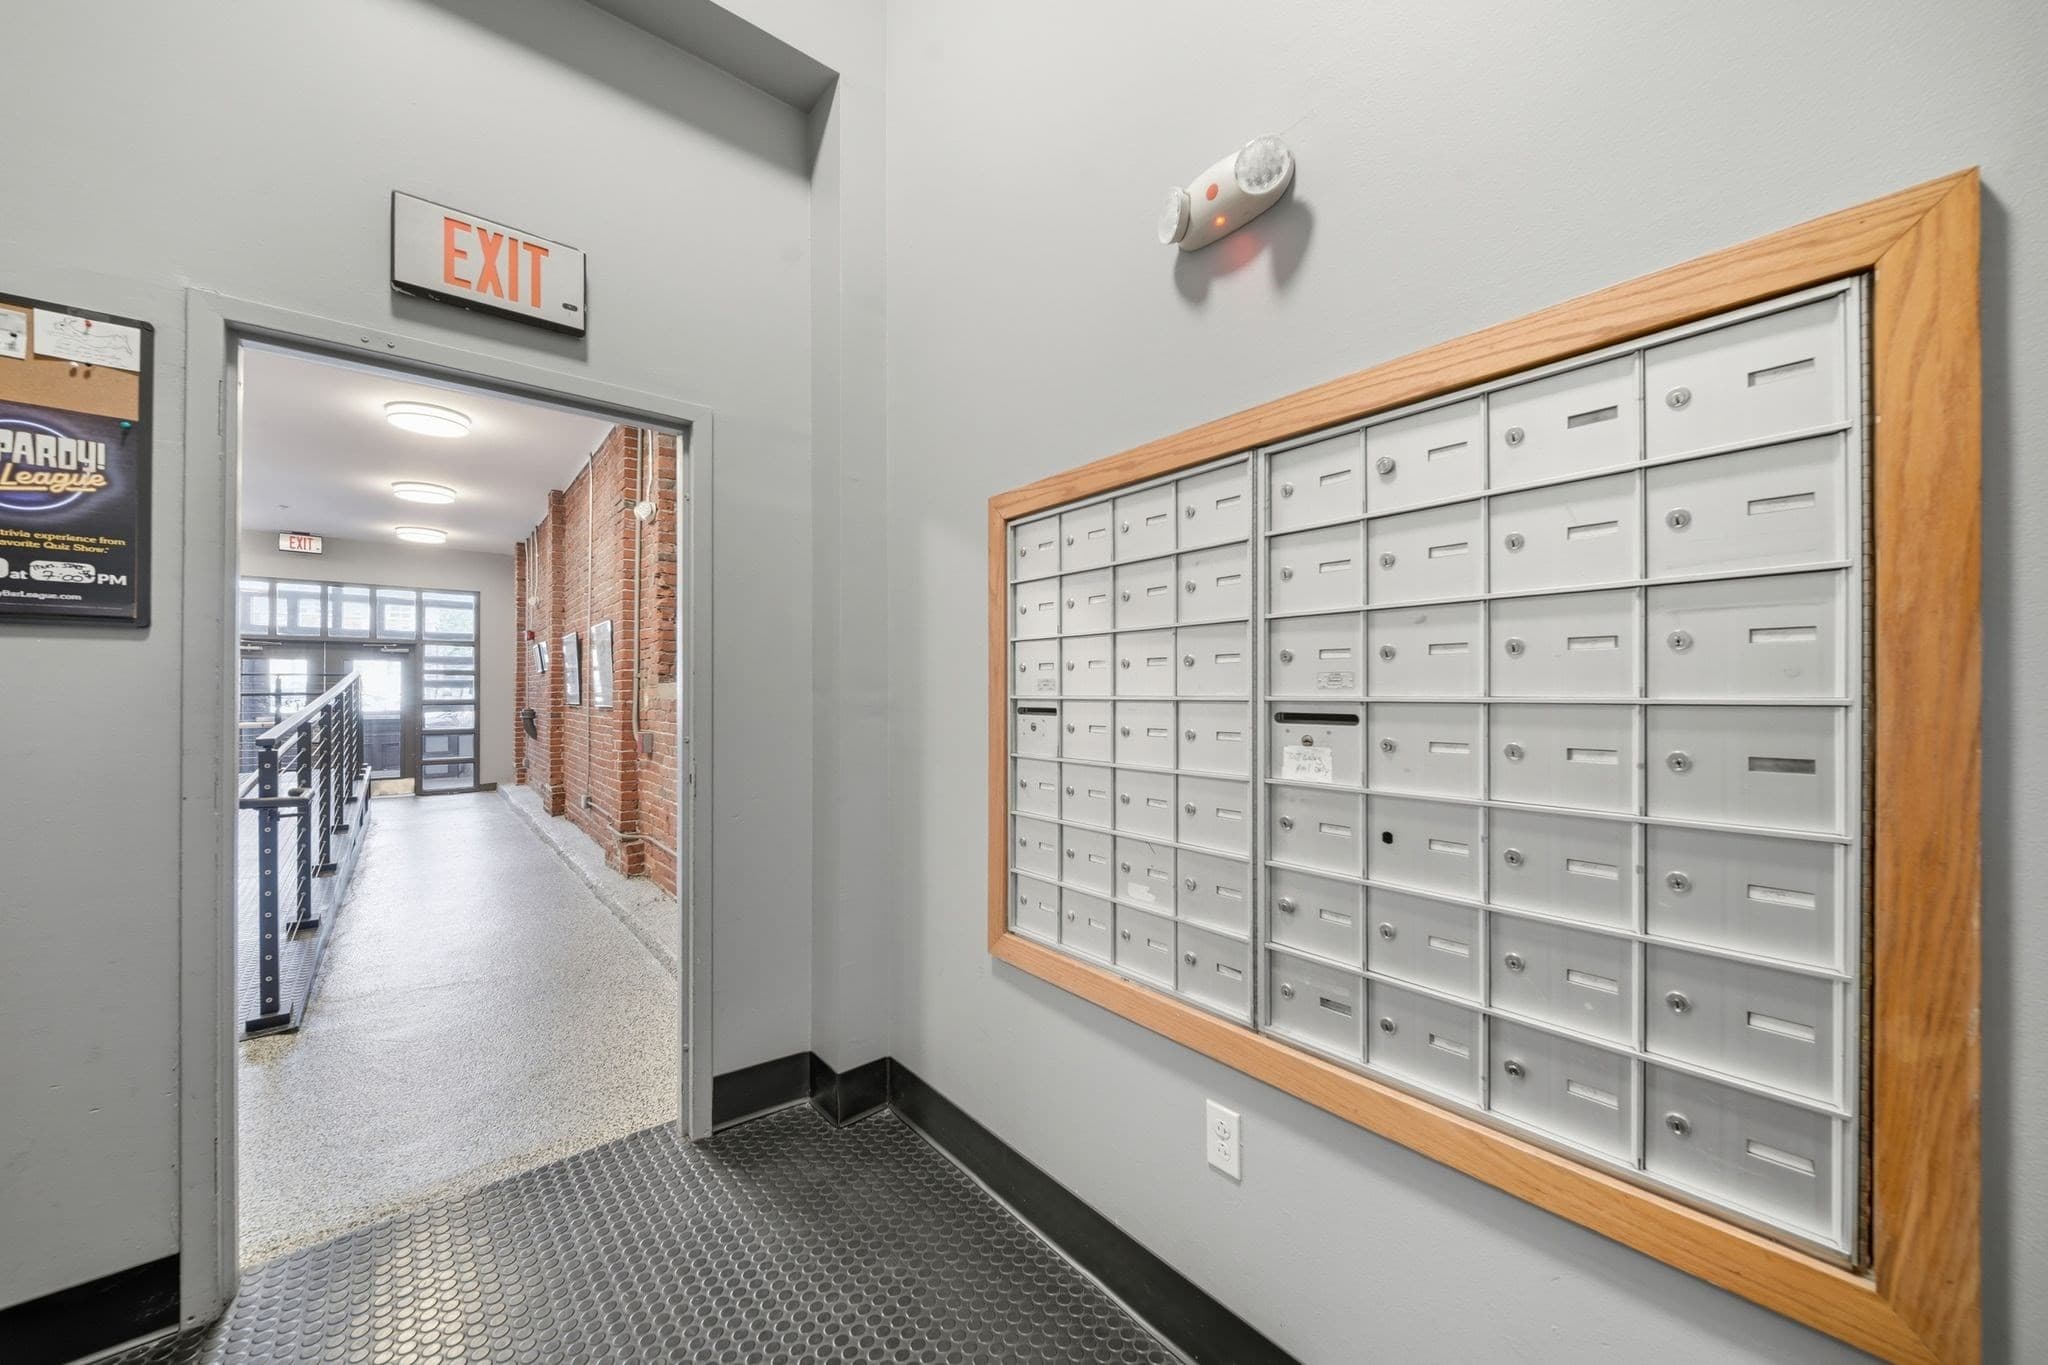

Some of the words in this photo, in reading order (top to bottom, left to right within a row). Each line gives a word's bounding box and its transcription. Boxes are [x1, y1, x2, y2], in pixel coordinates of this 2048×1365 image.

[444, 216, 549, 309] EXIT
[0, 428, 105, 472] PARDY!
[0, 463, 107, 493] League
[0, 528, 31, 538] trivia
[33, 531, 97, 544] experience
[99, 536, 126, 546] from
[43, 541, 70, 551] Quiz
[290, 535, 313, 550] EXIT
[9, 570, 29, 580] at
[97, 573, 127, 586] PM
